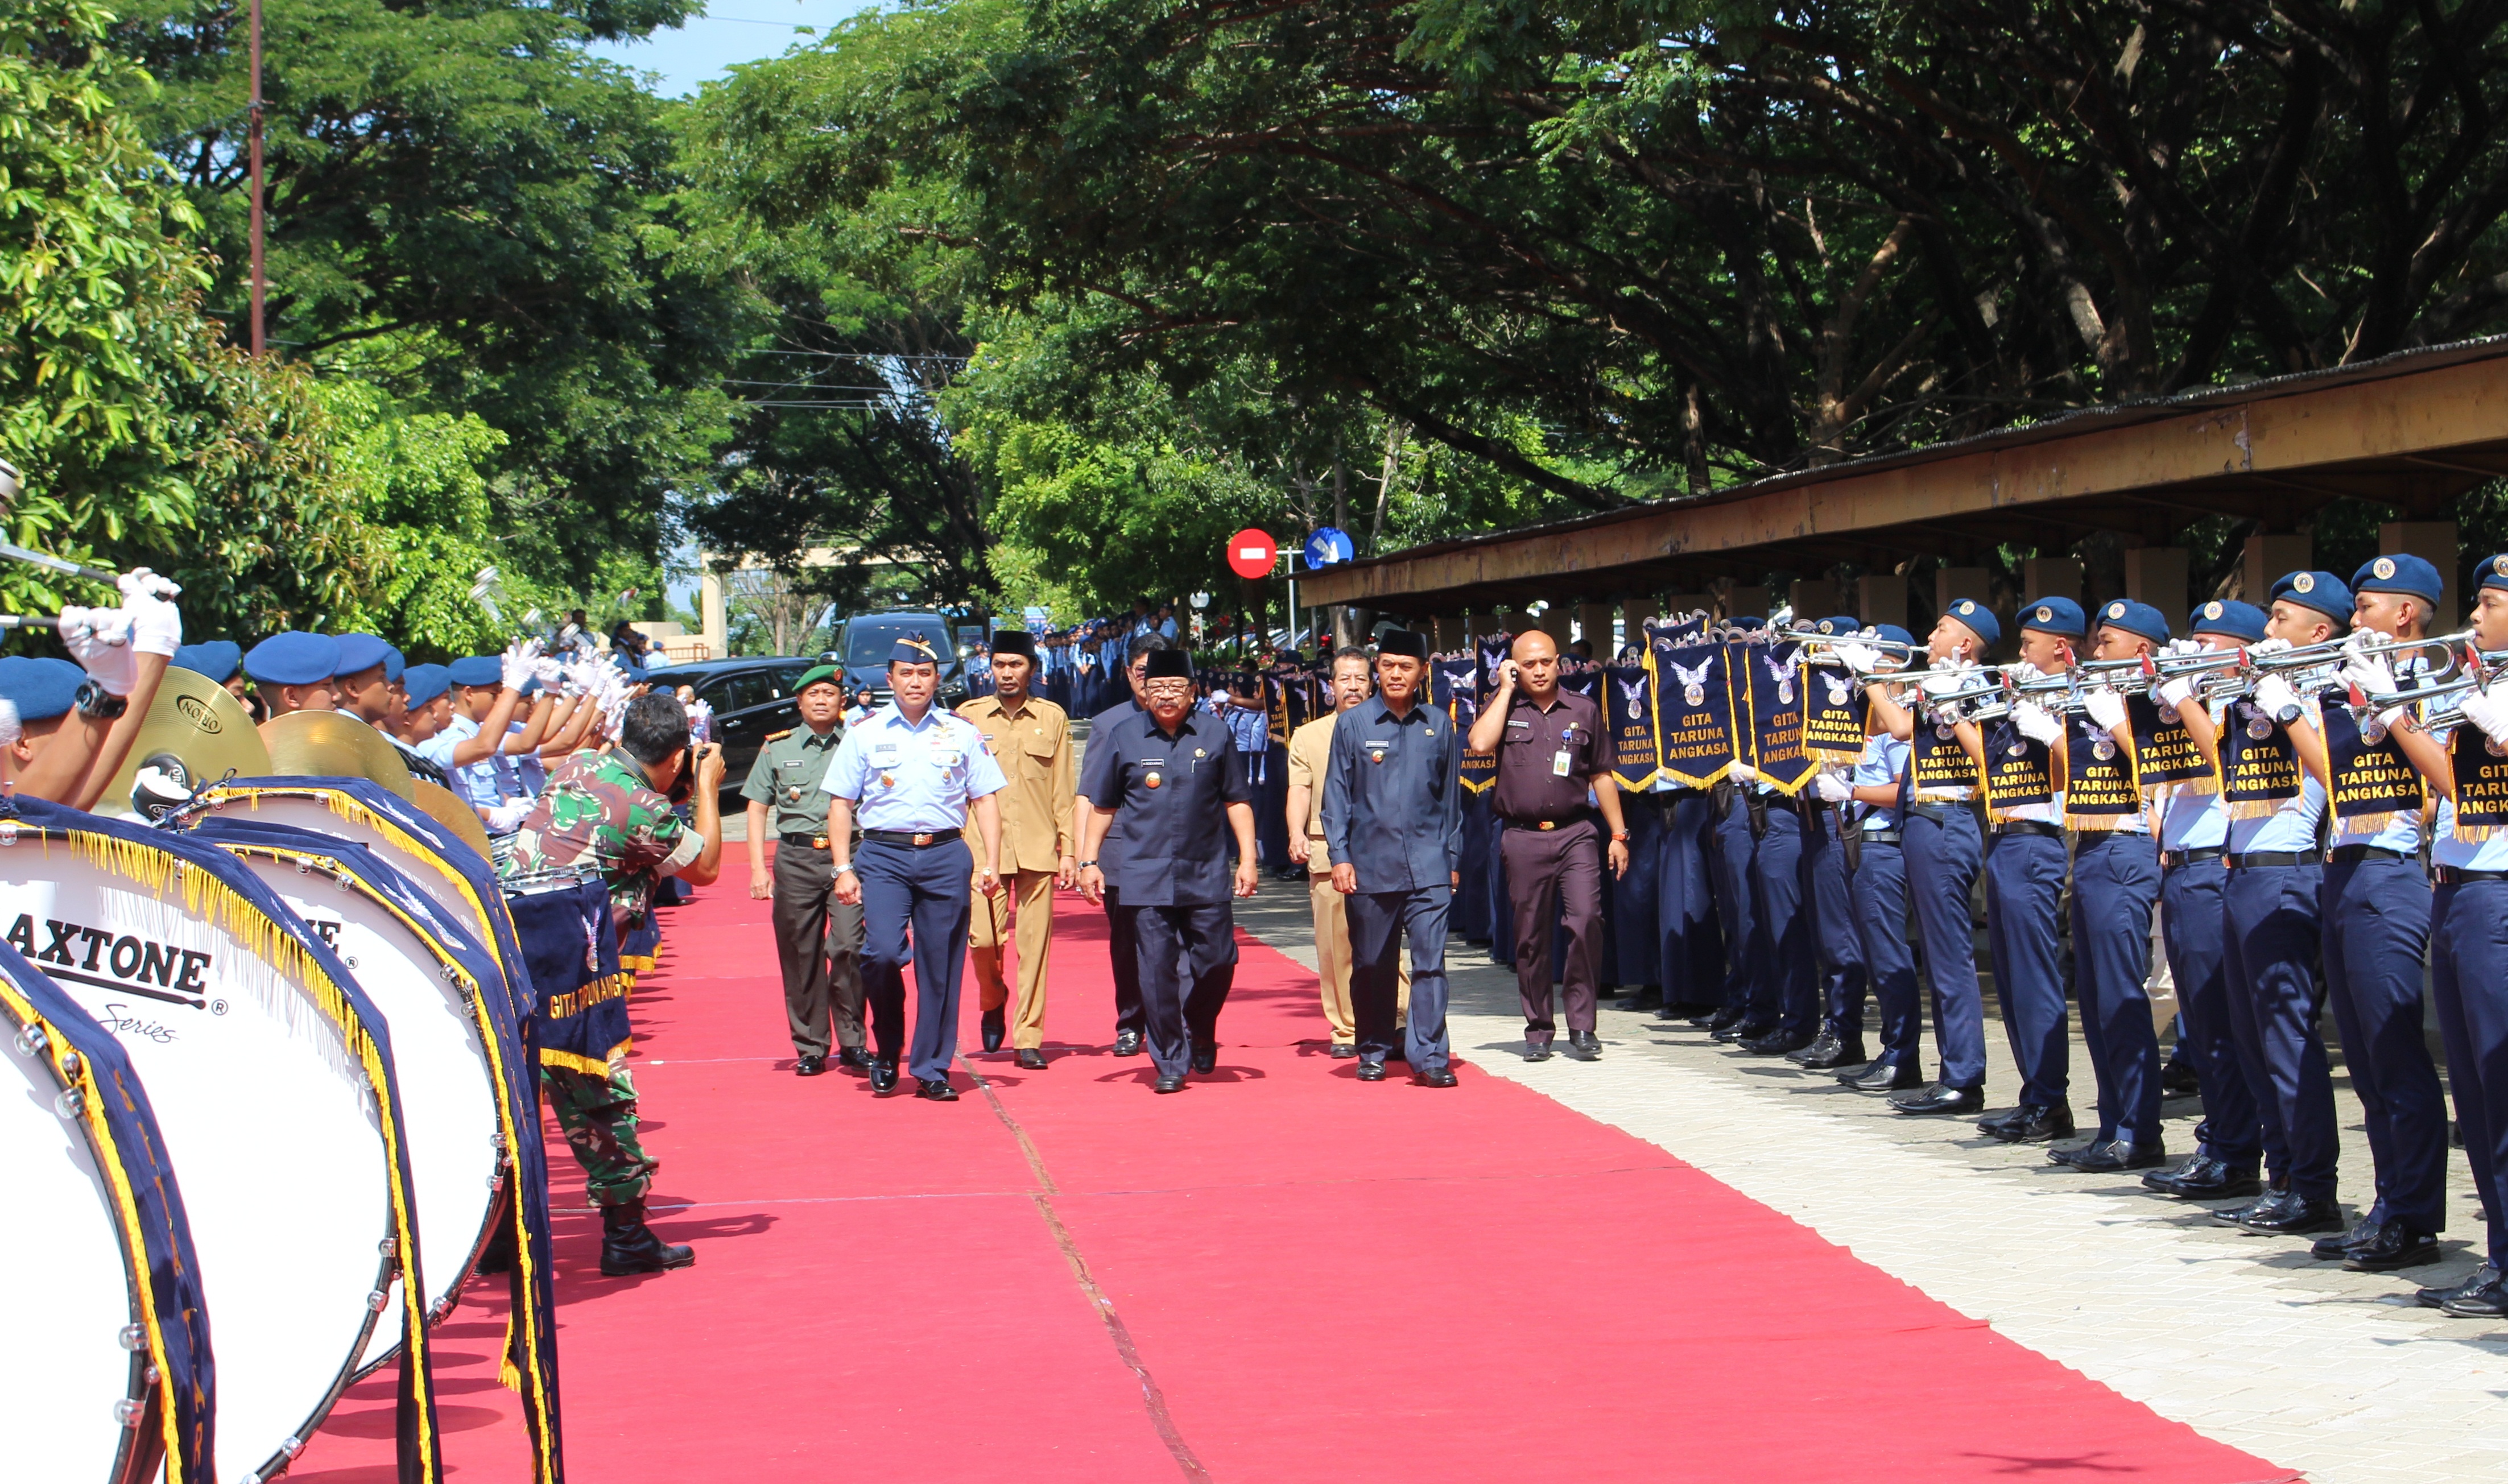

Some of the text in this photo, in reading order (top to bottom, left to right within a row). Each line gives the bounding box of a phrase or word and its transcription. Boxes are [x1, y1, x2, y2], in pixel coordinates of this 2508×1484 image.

[183, 701, 218, 730] ORION
[1683, 713, 1713, 727] GITA
[1773, 712, 1798, 727] GITA
[1822, 709, 1851, 721] GITA
[1625, 726, 1646, 737] GITA
[1811, 720, 1861, 732] TARUNA
[1671, 727, 1724, 744] TARUNA
[1806, 731, 1862, 743] ANGKASA
[2154, 729, 2190, 742] GITA
[1618, 739, 1653, 751] TARUNA
[1670, 742, 1729, 760] ANGKASA
[1931, 745, 1961, 757] GITA
[2141, 741, 2200, 759] TARUN
[2241, 746, 2279, 761] GITA
[2353, 753, 2395, 768] GITA
[1461, 760, 1496, 769] ANGKASA
[1920, 756, 1974, 768] TARUNA
[2002, 760, 2034, 774] GITA
[2140, 755, 2207, 774] ANGKAS
[1918, 768, 1978, 780] ANGKASA
[1991, 772, 2046, 787] TARUNA
[2086, 767, 2119, 778] GITA
[2338, 767, 2412, 786] TARUNA
[2072, 780, 2133, 791] TARUNA
[2225, 775, 2300, 792] ANGKASA
[1990, 784, 2050, 800] ANGKASA
[2068, 793, 2137, 805] ANGKASA
[2336, 783, 2419, 803] ANGKASA
[6, 913, 212, 994] AXTONE
[550, 991, 577, 1019] GITA
[97, 1003, 180, 1043] Series
